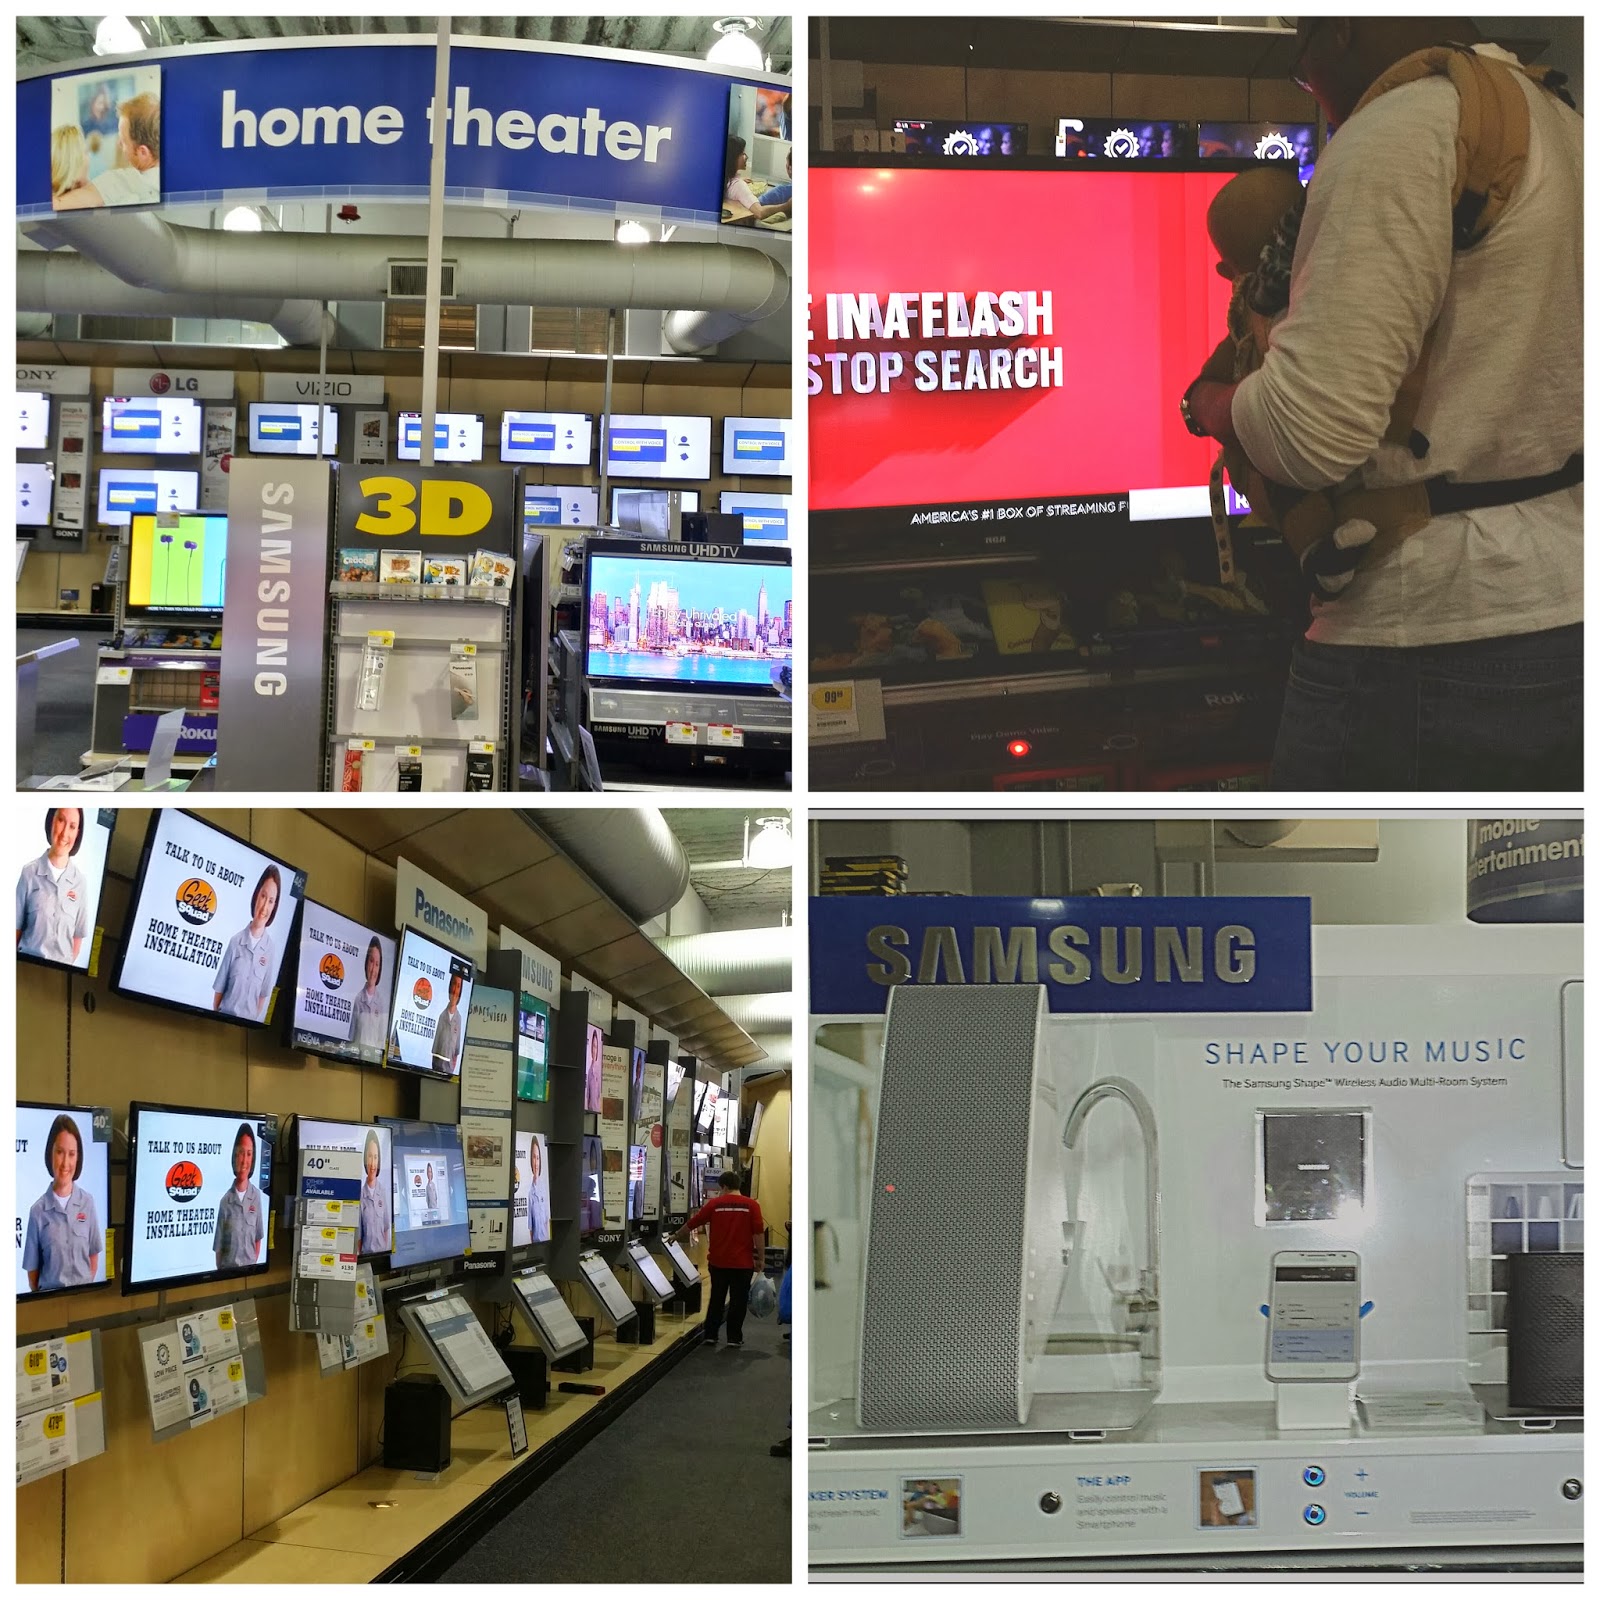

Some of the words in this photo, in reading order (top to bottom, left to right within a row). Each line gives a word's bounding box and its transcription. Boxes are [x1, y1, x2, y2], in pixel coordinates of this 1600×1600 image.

[222, 89, 403, 148] home
[914, 346, 1063, 392] SEARCH
[176, 377, 199, 392] LG
[296, 381, 352, 396] VIZIO
[355, 476, 493, 536] 3D
[910, 509, 978, 525] AMERICA'S
[980, 508, 994, 521] #1
[997, 506, 1023, 520] BOX
[1025, 505, 1044, 518] OF
[1046, 501, 1116, 517] STREAMING
[55, 529, 79, 538] SONY
[640, 543, 687, 554] SAMSUNG
[254, 482, 294, 696] SAMSUNG
[178, 725, 218, 740] Roku
[593, 725, 627, 734] SAMSUNG
[1480, 819, 1540, 844] mobile
[165, 840, 190, 864] TALK
[192, 853, 204, 870] TO
[205, 859, 217, 875] US
[217, 866, 245, 888] ABOUT
[183, 880, 212, 912] Geek
[415, 887, 475, 945] Panasonic
[148, 917, 179, 940] HOME
[181, 927, 223, 955] THEATER
[309, 927, 324, 943] TALK
[326, 933, 334, 947] TO
[334, 938, 341, 951] US
[342, 941, 359, 958] ABOUT
[144, 933, 221, 970] INSTALLATION
[866, 925, 1256, 985] SAMSUNG
[408, 955, 420, 970] TALK
[420, 960, 426, 972] TO
[426, 963, 432, 975] US
[432, 966, 446, 981] ABOUT
[522, 953, 553, 993] MSUNG
[305, 987, 323, 1003] HOME
[324, 993, 352, 1012] THEATER
[304, 999, 351, 1024] INSTALLATION
[401, 1008, 415, 1022] HOME
[415, 1012, 437, 1028] THEATER
[399, 1018, 435, 1040] INSTALLATION
[602, 1054, 618, 1063] mage
[1204, 1041, 1309, 1065] SHAPE
[1323, 1041, 1410, 1064] YOUR
[1425, 1038, 1527, 1063] MUSIC
[1222, 1078, 1242, 1089] The
[1244, 1078, 1292, 1090] Samsung
[1334, 1077, 1377, 1088] Wireless
[1379, 1077, 1408, 1088] Audio
[1409, 1076, 1469, 1087] Multi-Room
[1470, 1076, 1508, 1088] System
[148, 1140, 171, 1153] TALK
[173, 1141, 184, 1154] TO
[186, 1142, 196, 1154] US
[197, 1143, 223, 1155] ABOUT
[171, 1163, 197, 1189] Geek
[305, 1188, 335, 1196] AVAILABLE
[147, 1210, 173, 1224] HOME
[177, 1208, 215, 1222] THEATER
[146, 1221, 214, 1239] INSTALLATION
[598, 1233, 622, 1243] SONY
[463, 1259, 497, 1271] Panasonic
[153, 1369, 165, 1379] LOW
[164, 1364, 178, 1375] PRICE
[1076, 1476, 1102, 1487] THE
[1106, 1475, 1132, 1486] APP
[838, 1489, 889, 1500] SYSTEM
